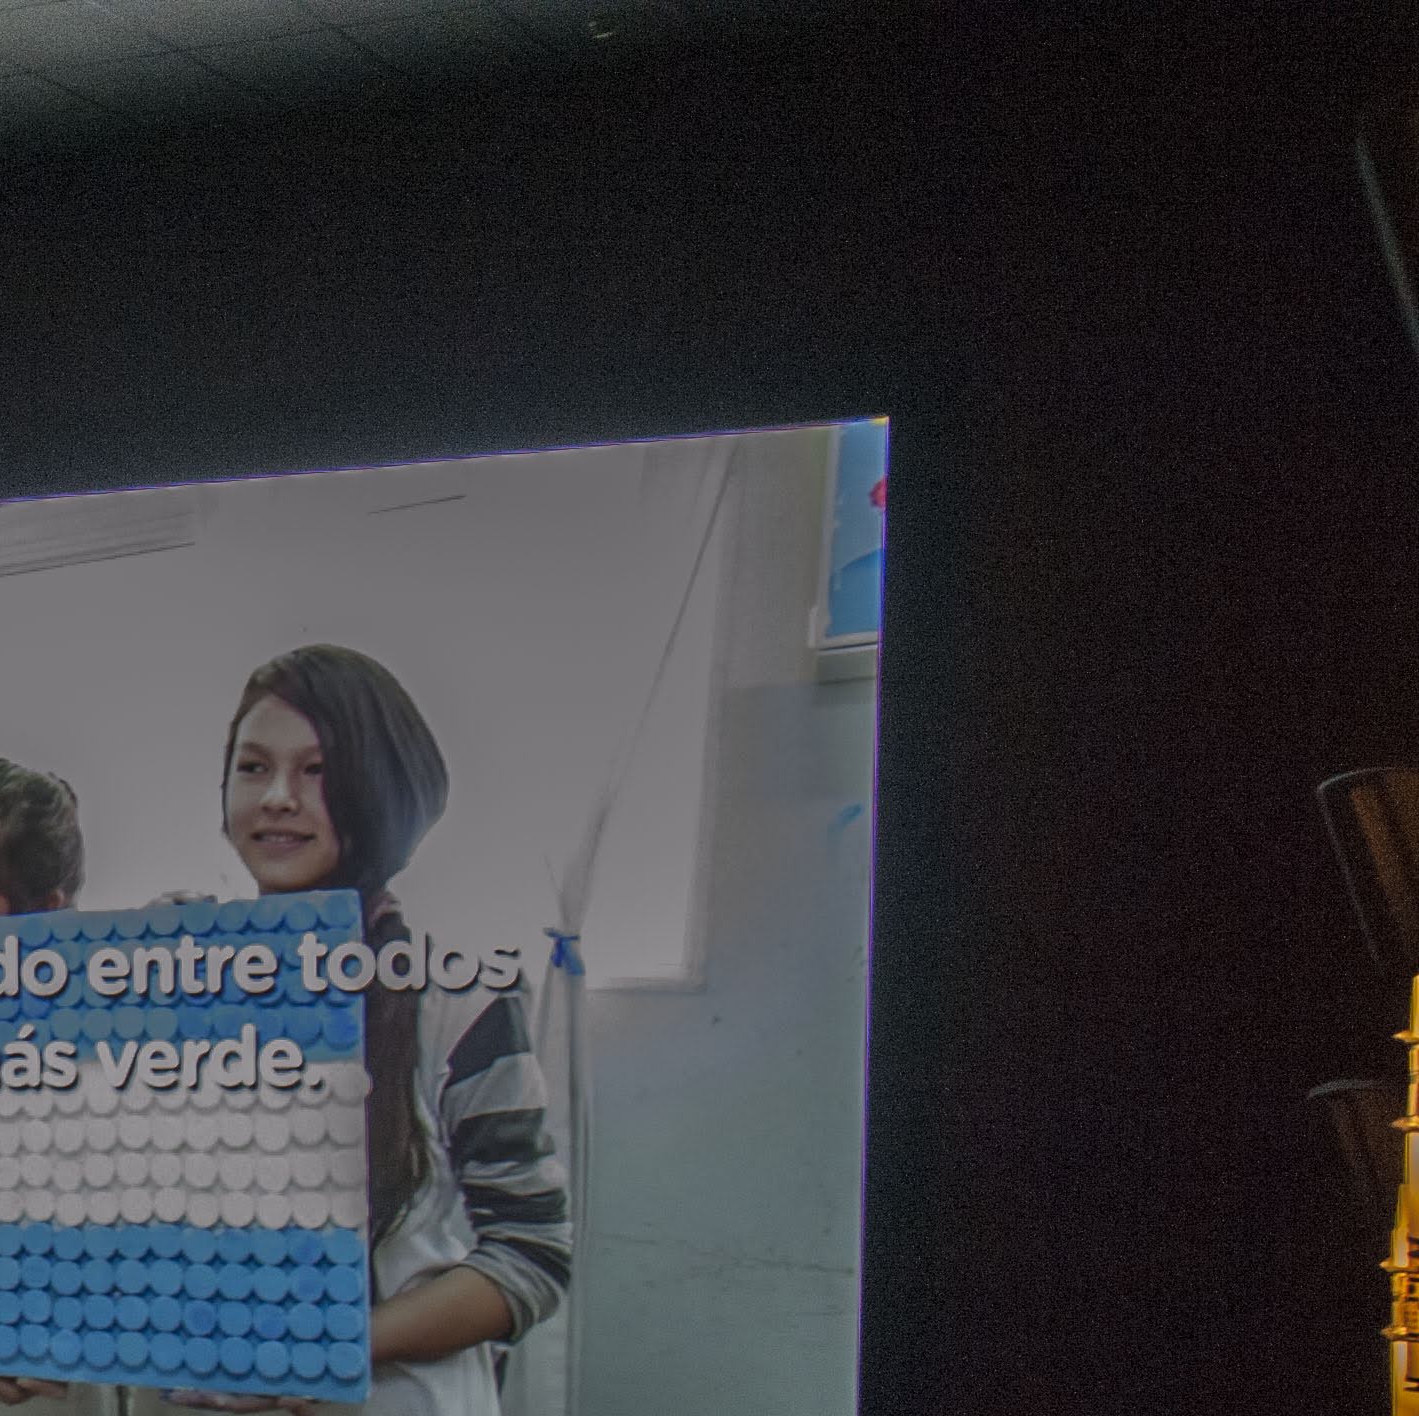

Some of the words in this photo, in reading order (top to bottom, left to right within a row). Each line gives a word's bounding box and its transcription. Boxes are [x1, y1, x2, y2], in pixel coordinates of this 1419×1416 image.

[88, 935, 278, 995] entre
[297, 932, 522, 993] todos
[96, 1023, 326, 1089] verde.
